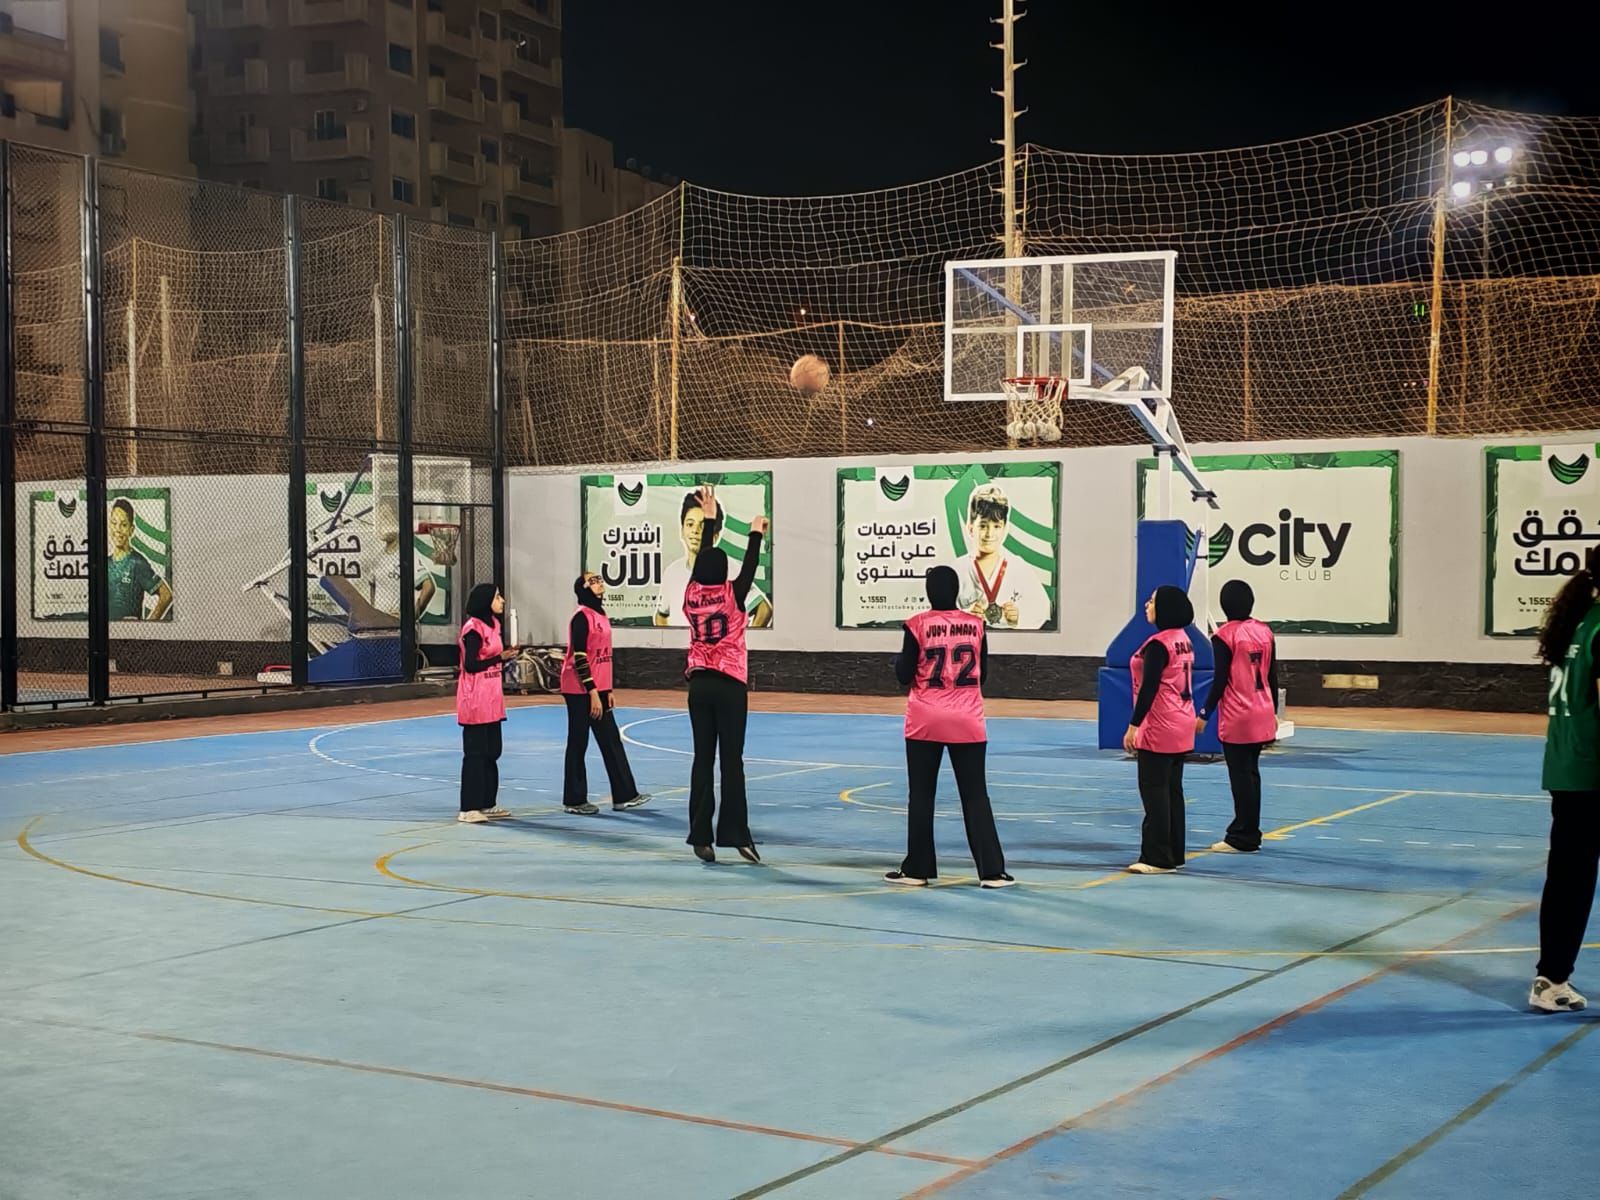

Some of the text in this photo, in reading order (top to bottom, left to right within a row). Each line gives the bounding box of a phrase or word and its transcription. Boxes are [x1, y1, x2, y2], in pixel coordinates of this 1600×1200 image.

[857, 519, 936, 540] أكاديميات
[1238, 508, 1352, 568] city
[1279, 569, 1332, 581] CLUB
[868, 595, 887, 603] 15551
[689, 610, 730, 646] 10
[924, 643, 979, 689] 72
[1248, 650, 1264, 692] 7
